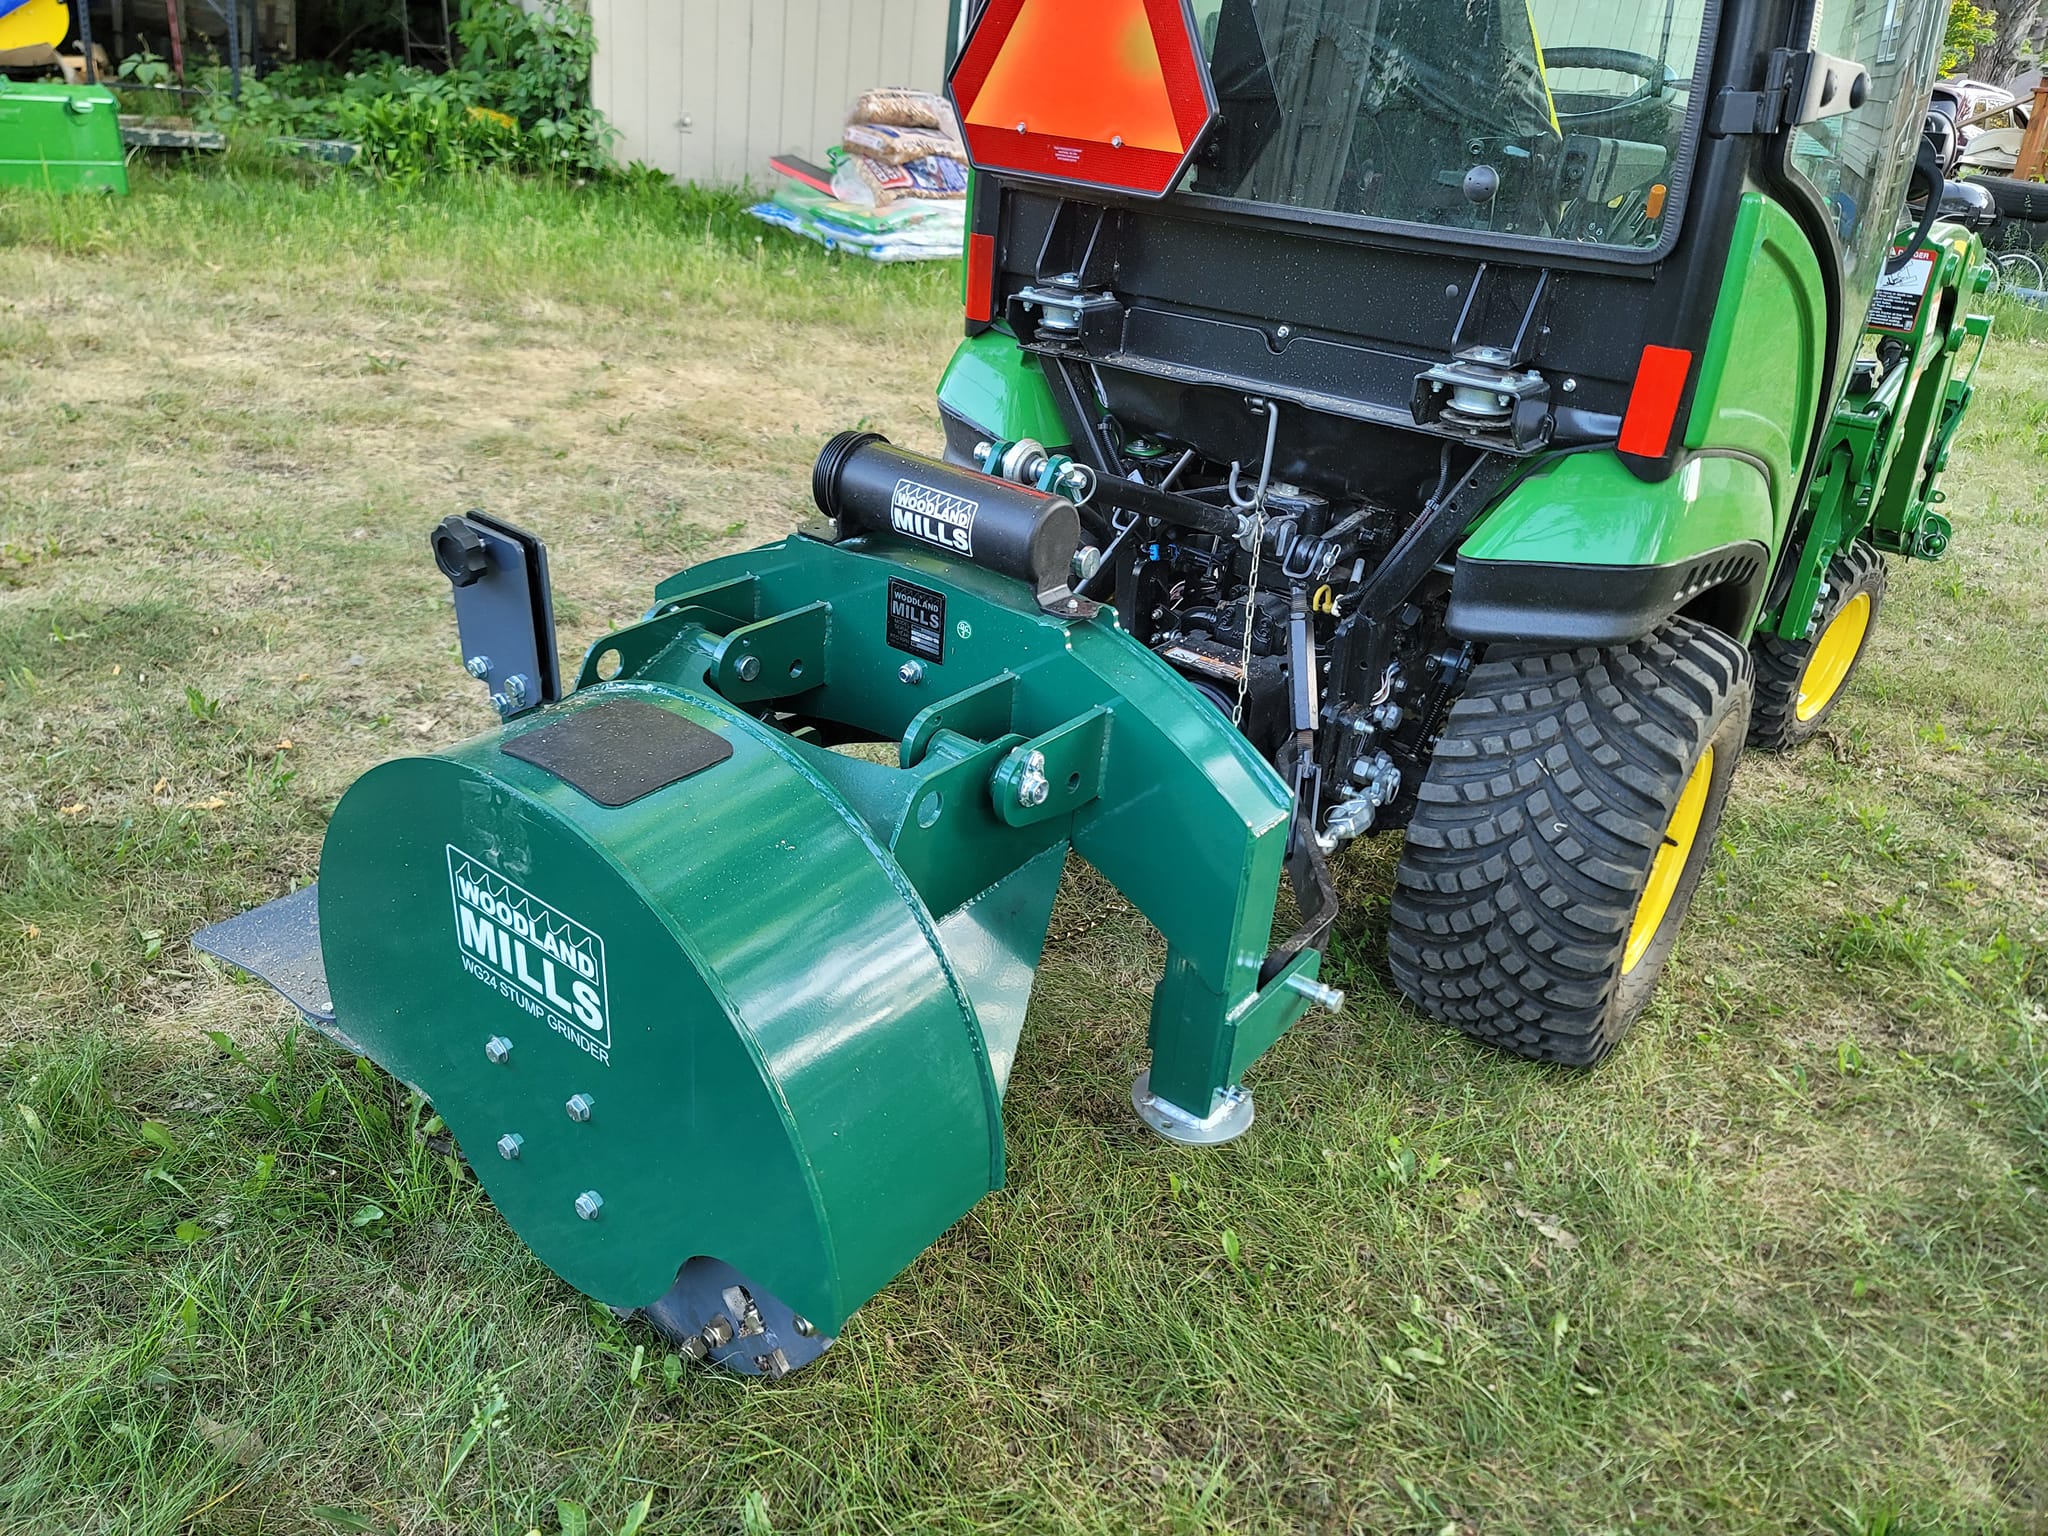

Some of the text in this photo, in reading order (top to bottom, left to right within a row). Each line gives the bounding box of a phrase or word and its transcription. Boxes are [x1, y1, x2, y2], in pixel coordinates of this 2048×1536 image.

[1898, 249, 1929, 259] DGER
[894, 507, 969, 551] MILLS
[897, 493, 969, 527] WOODLAND
[892, 600, 940, 629] MILLS
[894, 591, 939, 613] WOODLAND
[459, 876, 595, 979] WOODLAND
[460, 904, 603, 1031] MILLS
[461, 955, 610, 1067] WG24 STUMP GRINDER
